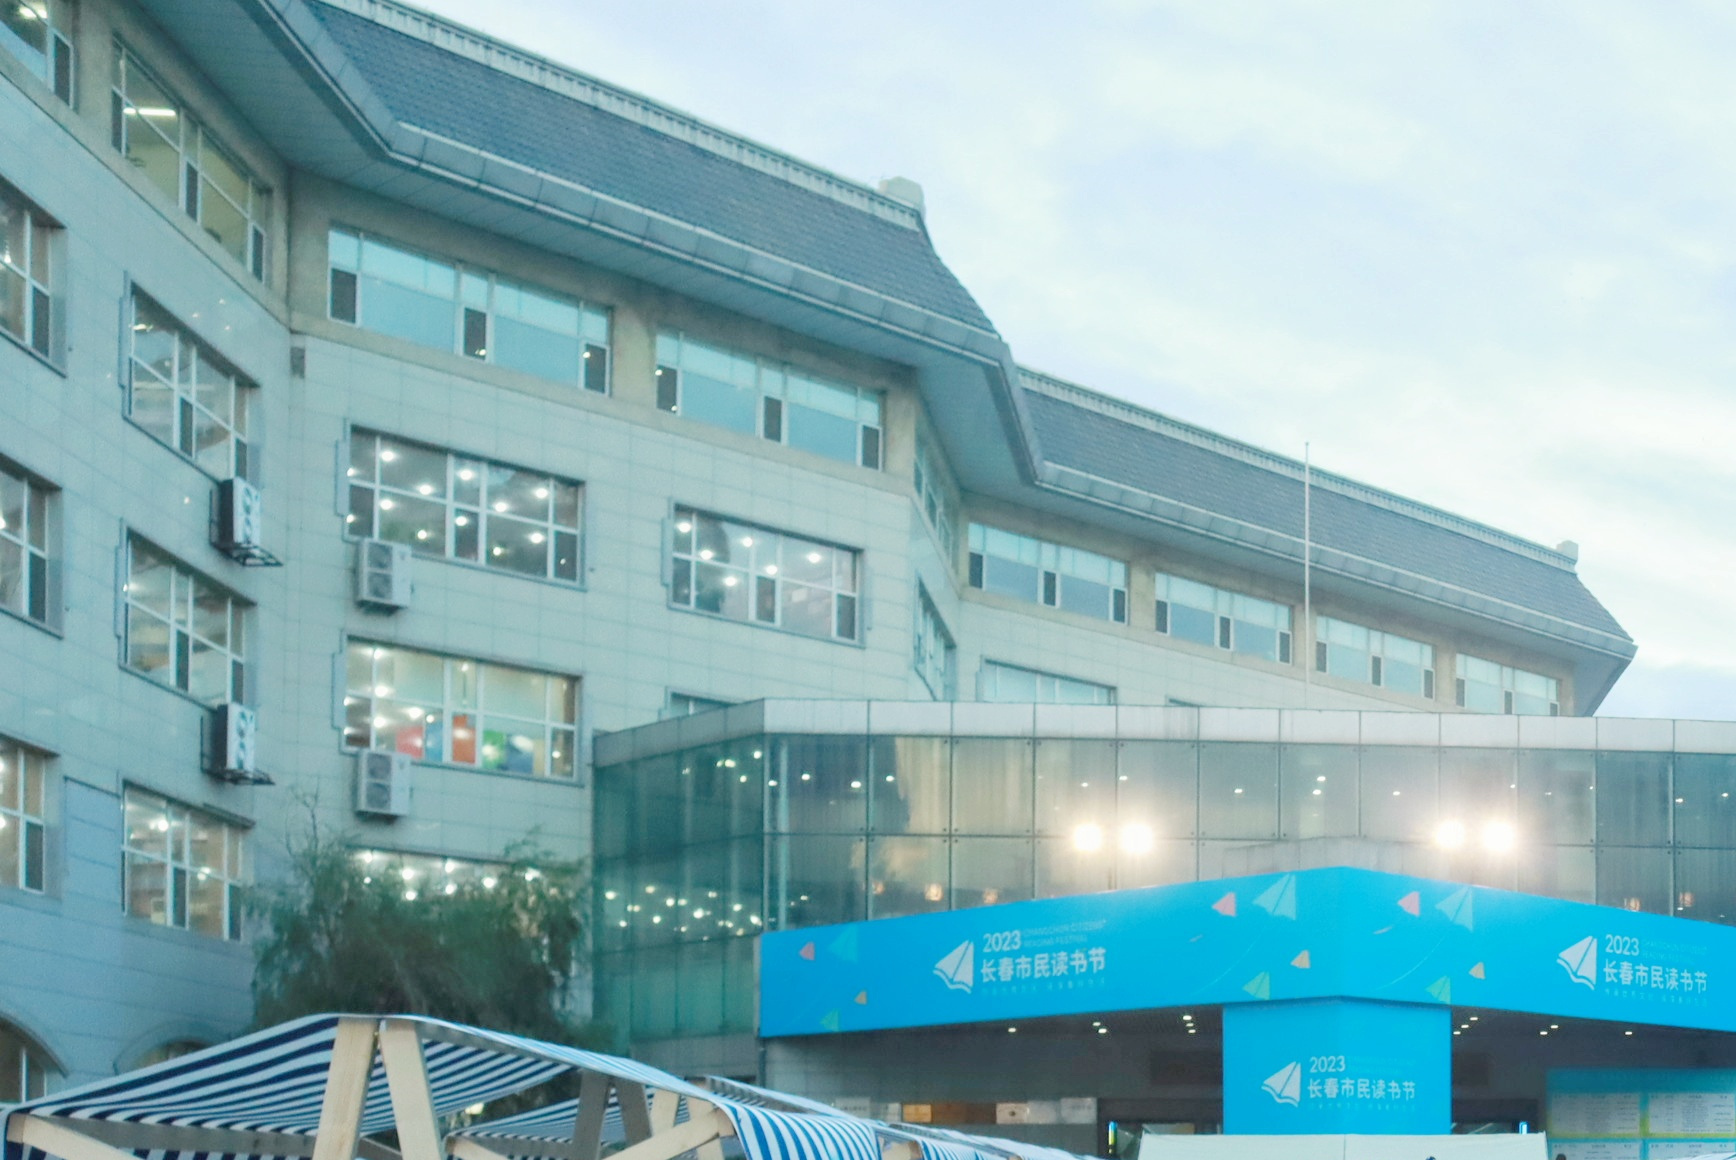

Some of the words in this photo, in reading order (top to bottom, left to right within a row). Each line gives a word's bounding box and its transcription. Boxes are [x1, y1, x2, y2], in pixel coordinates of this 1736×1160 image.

[983, 929, 1021, 953] 2023
[1605, 934, 1640, 956] 2023
[981, 946, 1106, 983] 长春市民读书节
[1603, 958, 1708, 994] 长春市民读书节
[1310, 1055, 1346, 1073] 2023
[1307, 1077, 1416, 1101] 长春市民读书节
